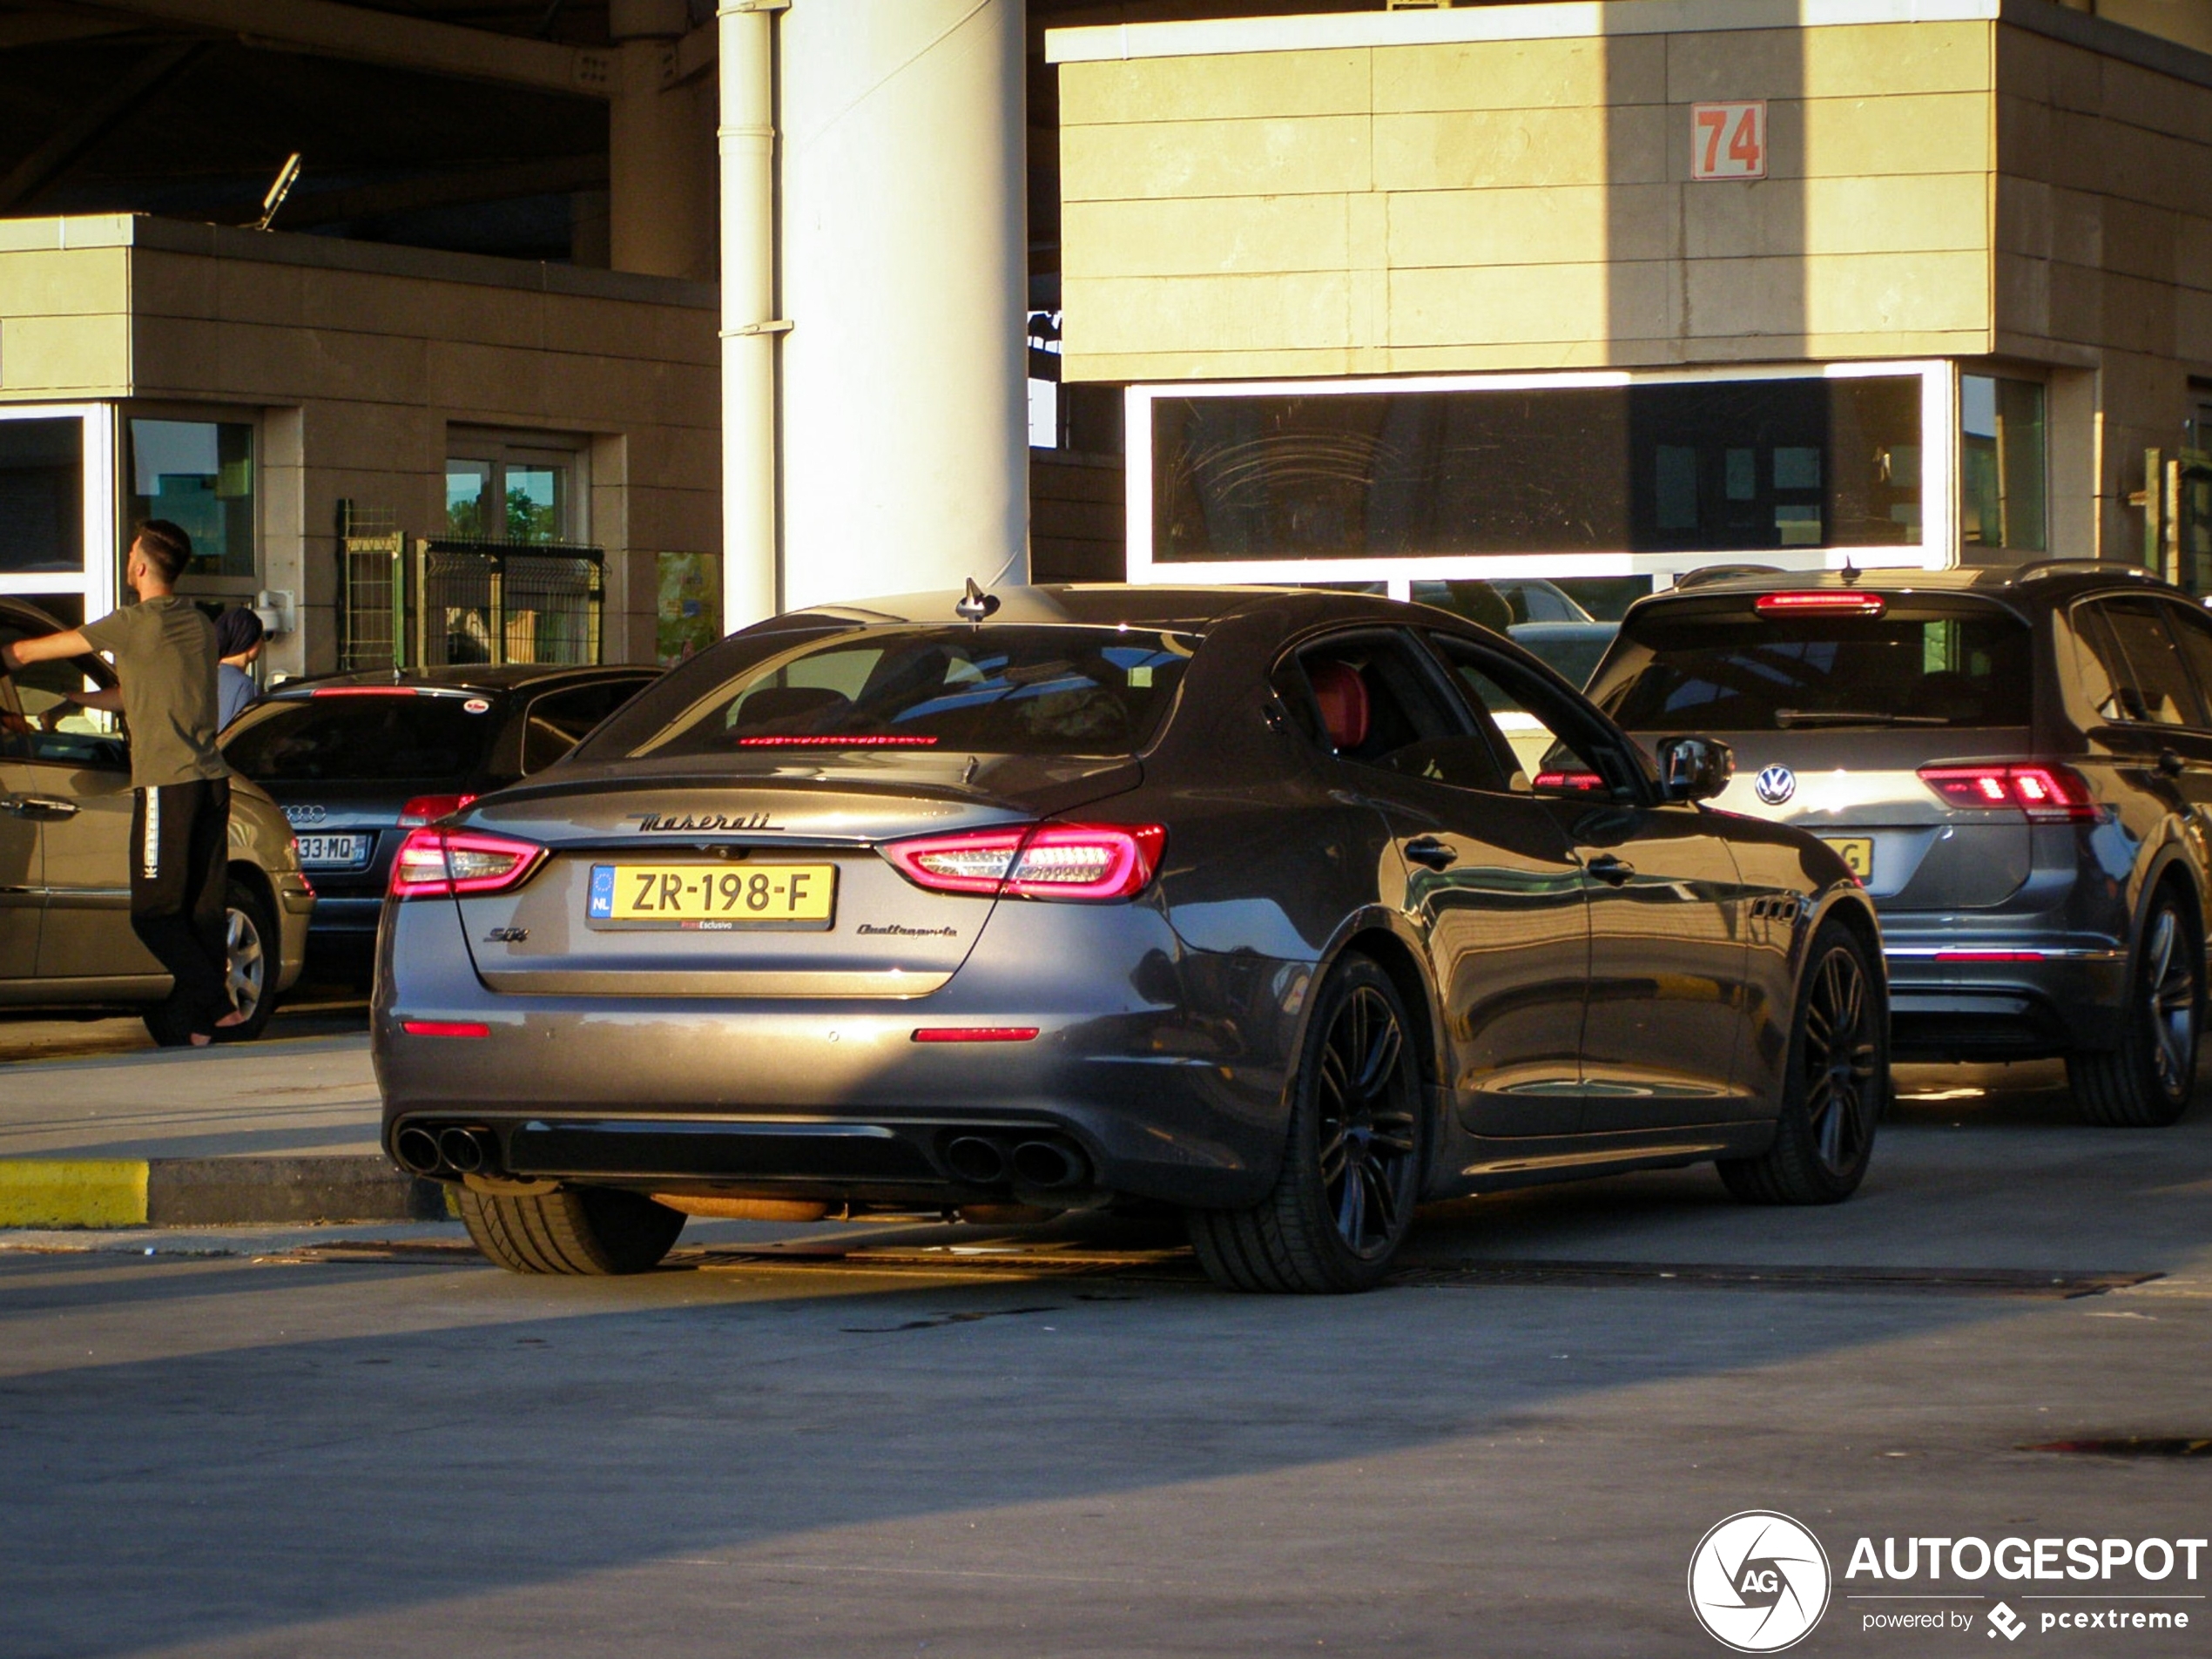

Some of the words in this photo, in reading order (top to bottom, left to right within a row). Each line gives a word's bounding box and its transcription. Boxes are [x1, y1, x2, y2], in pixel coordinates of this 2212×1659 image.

[1698, 107, 1760, 172] 74
[626, 813, 786, 832] Maserati
[592, 897, 610, 910] NL
[632, 873, 811, 911] ZR-198-F
